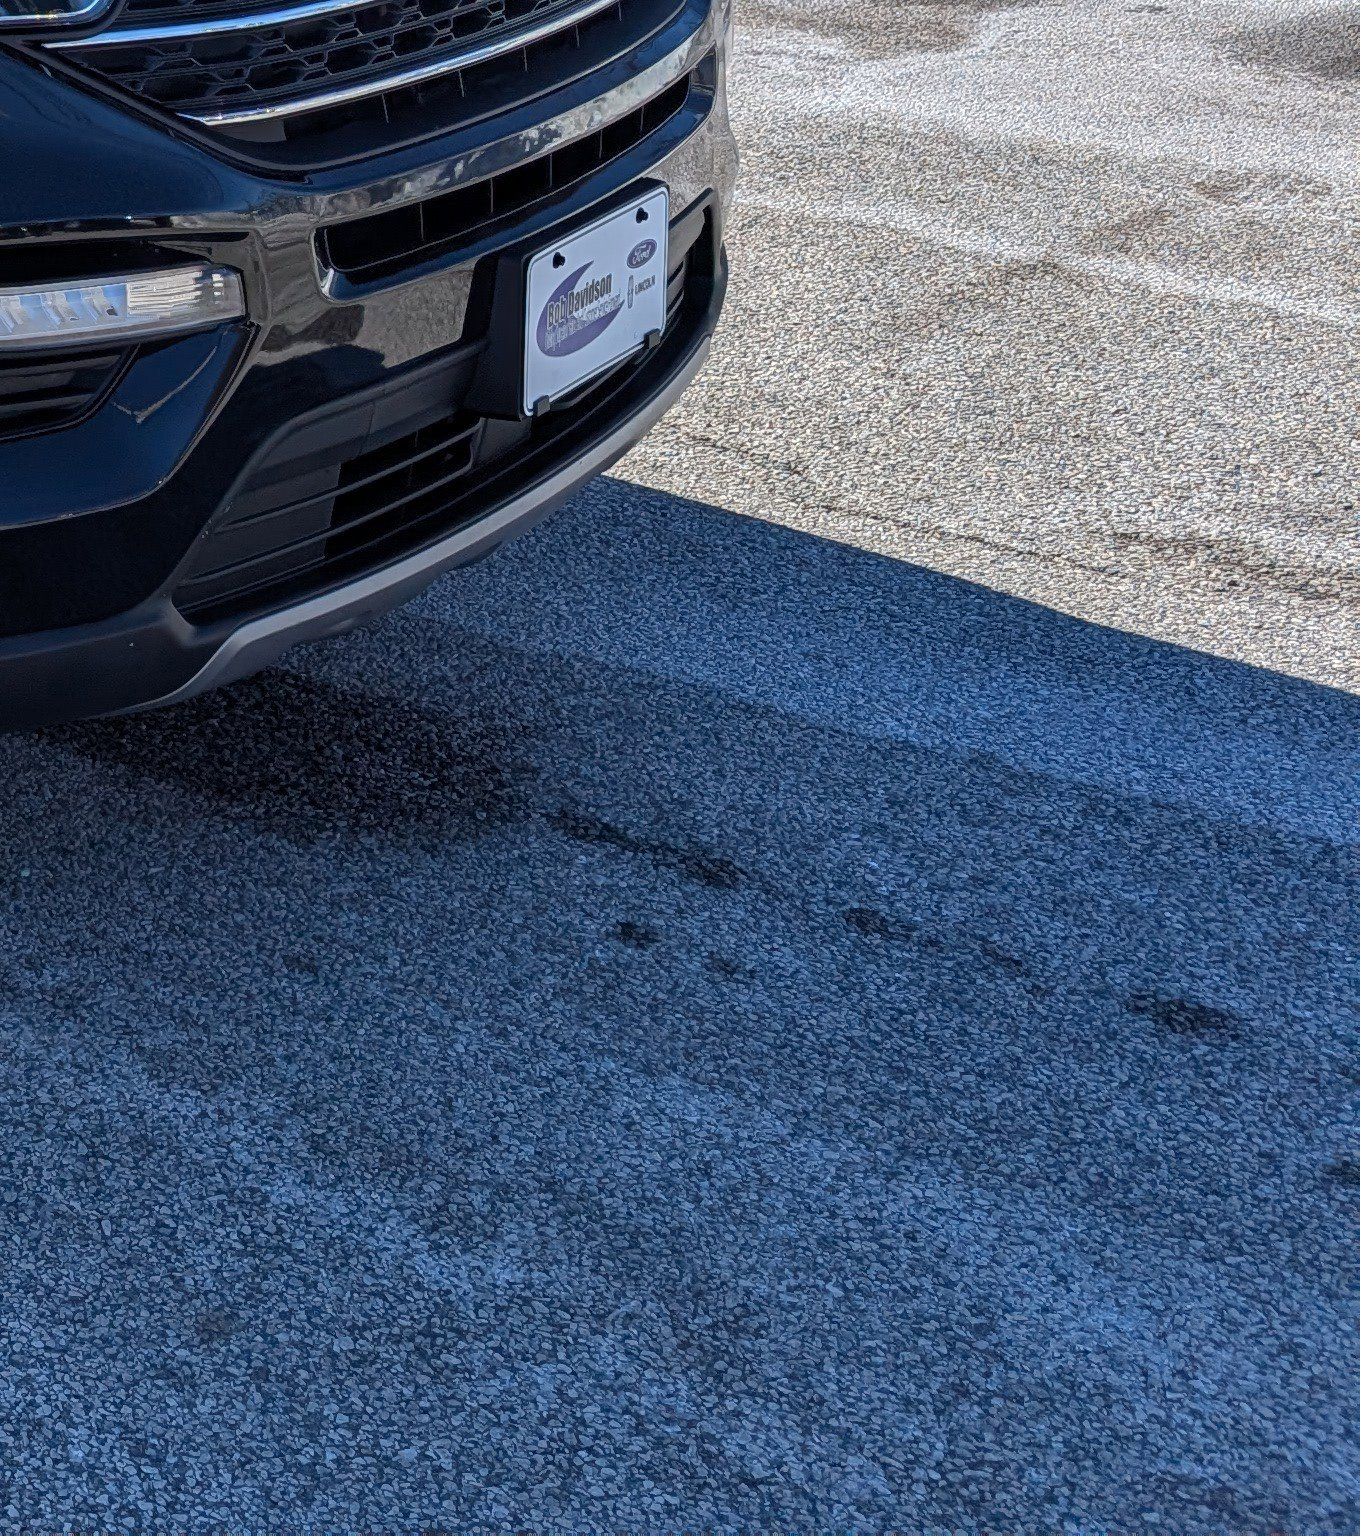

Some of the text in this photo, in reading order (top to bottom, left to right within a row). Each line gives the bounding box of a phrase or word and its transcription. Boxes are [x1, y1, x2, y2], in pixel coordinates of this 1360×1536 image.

[632, 243, 652, 265] Ford
[547, 295, 568, 330] Bob
[567, 272, 612, 318] Davidson
